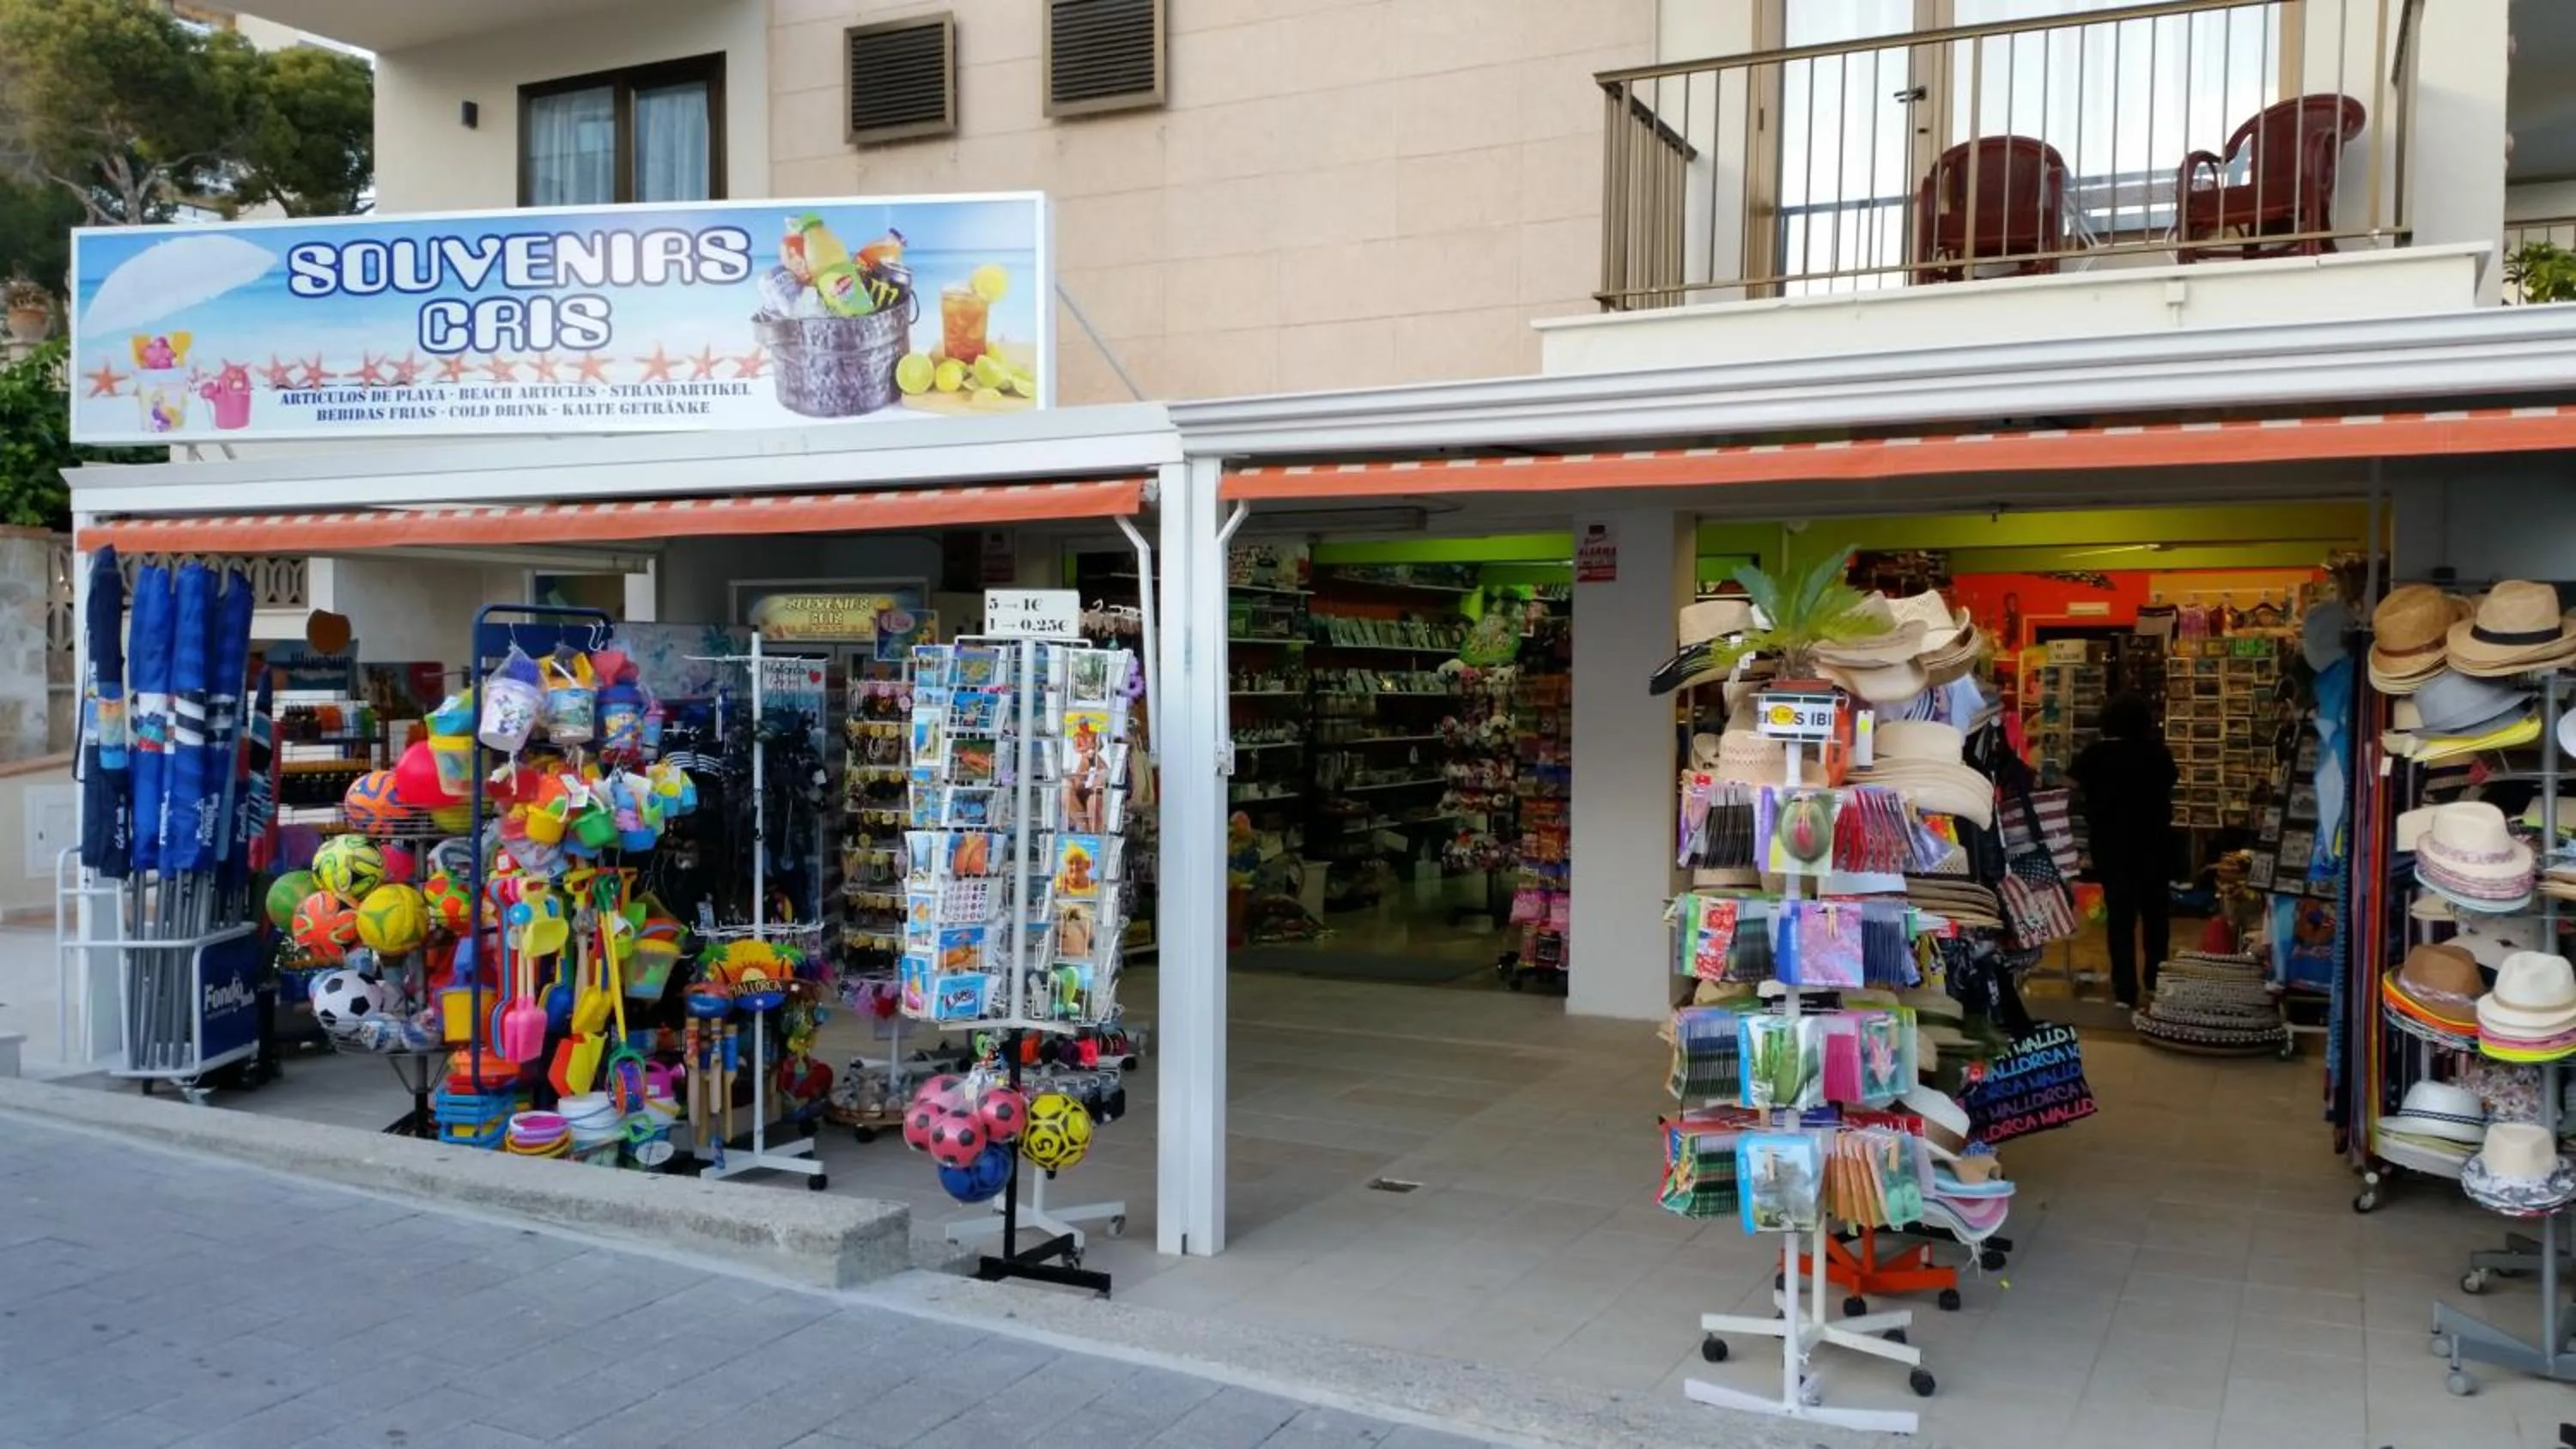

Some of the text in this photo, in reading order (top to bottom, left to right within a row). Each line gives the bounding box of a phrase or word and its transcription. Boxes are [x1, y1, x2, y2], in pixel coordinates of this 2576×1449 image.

[289, 226, 751, 298] SOUVENIRS
[419, 294, 611, 354] CRIS
[281, 382, 751, 405] ARTICULOS DE PLAYA BEACH ARTICLES STRANDARTIKEL
[316, 399, 711, 421] BEBIDAS FRIAS COLD DRINK KALTE GETRÄNKE
[989, 597, 998, 609] 5
[990, 617, 994, 629] 1
